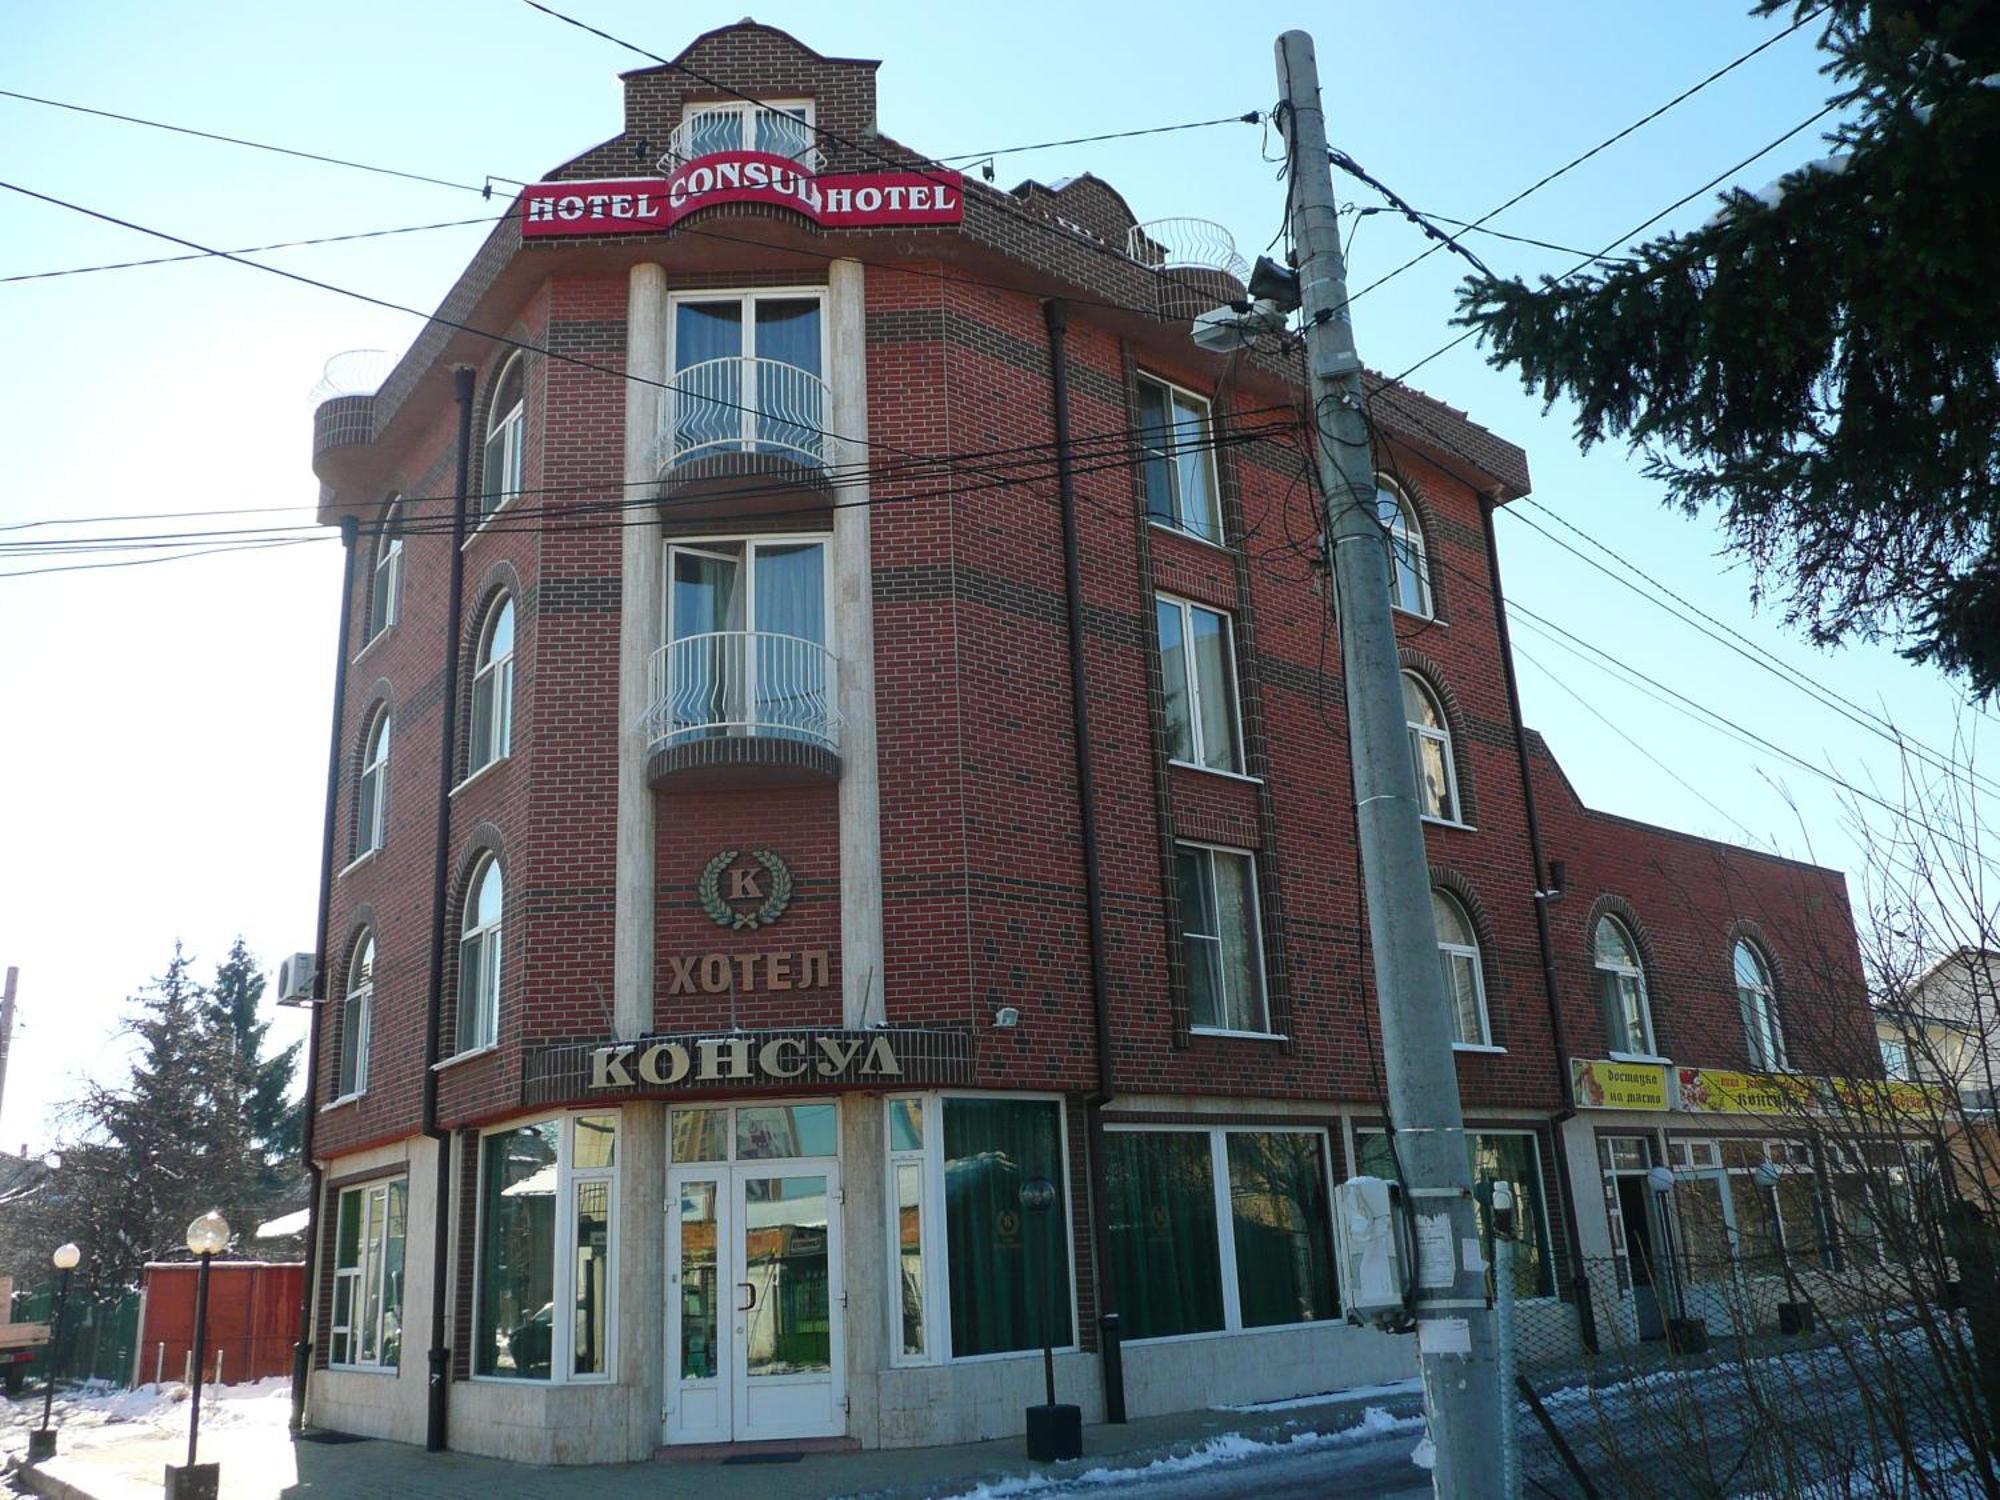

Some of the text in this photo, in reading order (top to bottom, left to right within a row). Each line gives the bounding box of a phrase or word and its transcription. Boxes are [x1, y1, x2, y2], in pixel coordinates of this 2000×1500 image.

[529, 161, 957, 222] HOTEL CONSUL HOTEL
[670, 951, 829, 994] ХОТЕЛ
[588, 1037, 904, 1089] КОНСУЛ
